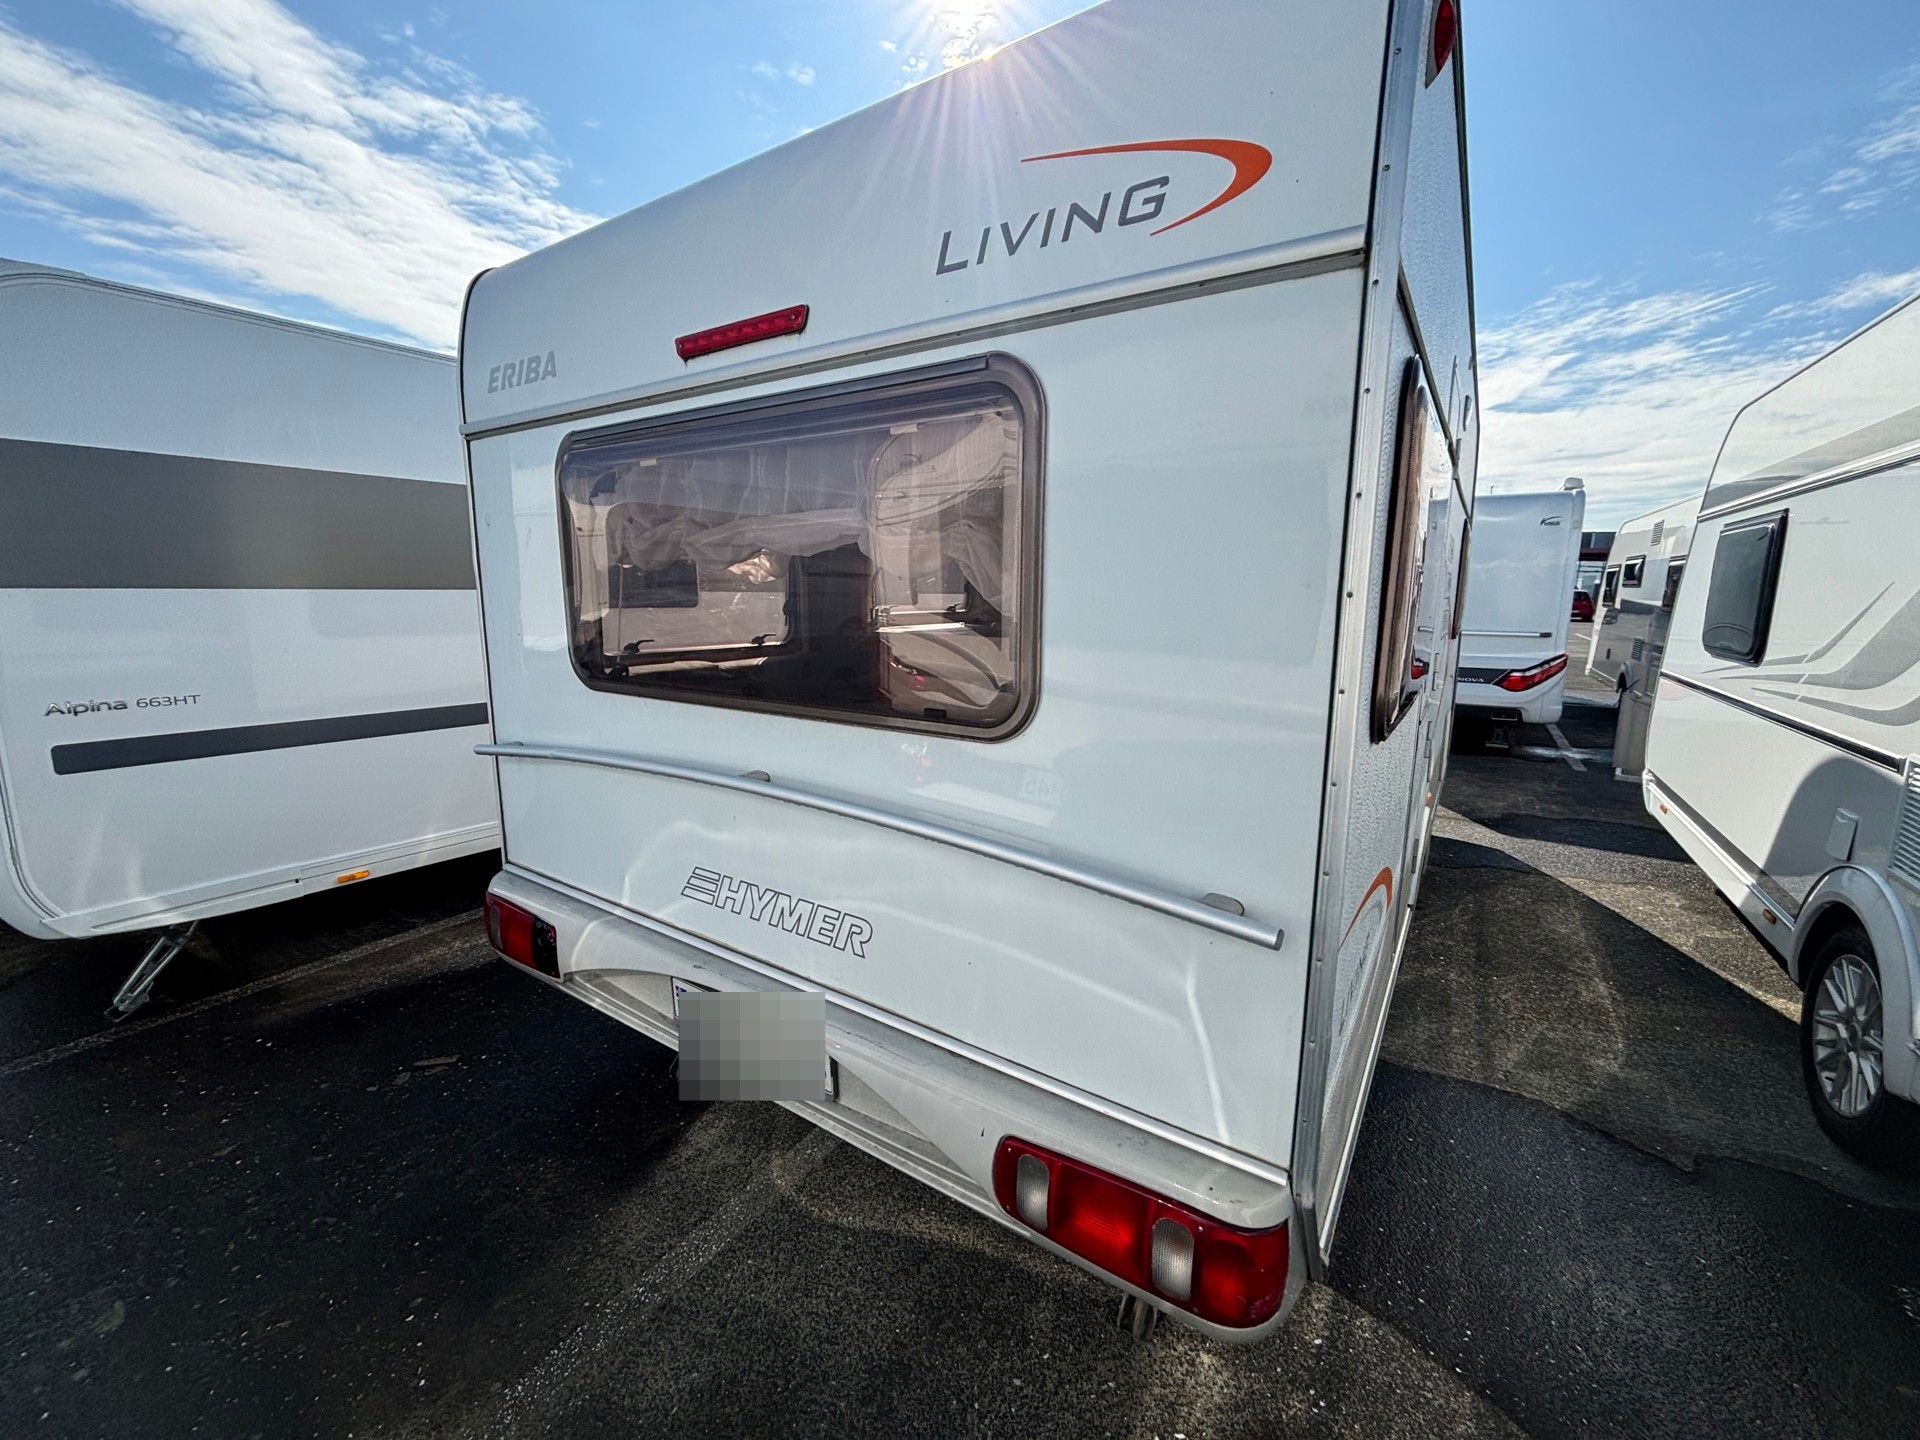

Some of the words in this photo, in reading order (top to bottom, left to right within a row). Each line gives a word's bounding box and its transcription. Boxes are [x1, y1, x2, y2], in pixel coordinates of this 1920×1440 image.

[936, 175, 1170, 276] LIVING
[487, 350, 557, 394] ERIBA
[44, 699, 128, 717] Alpina
[136, 694, 201, 708] 663HT
[714, 874, 874, 959] HYMER
